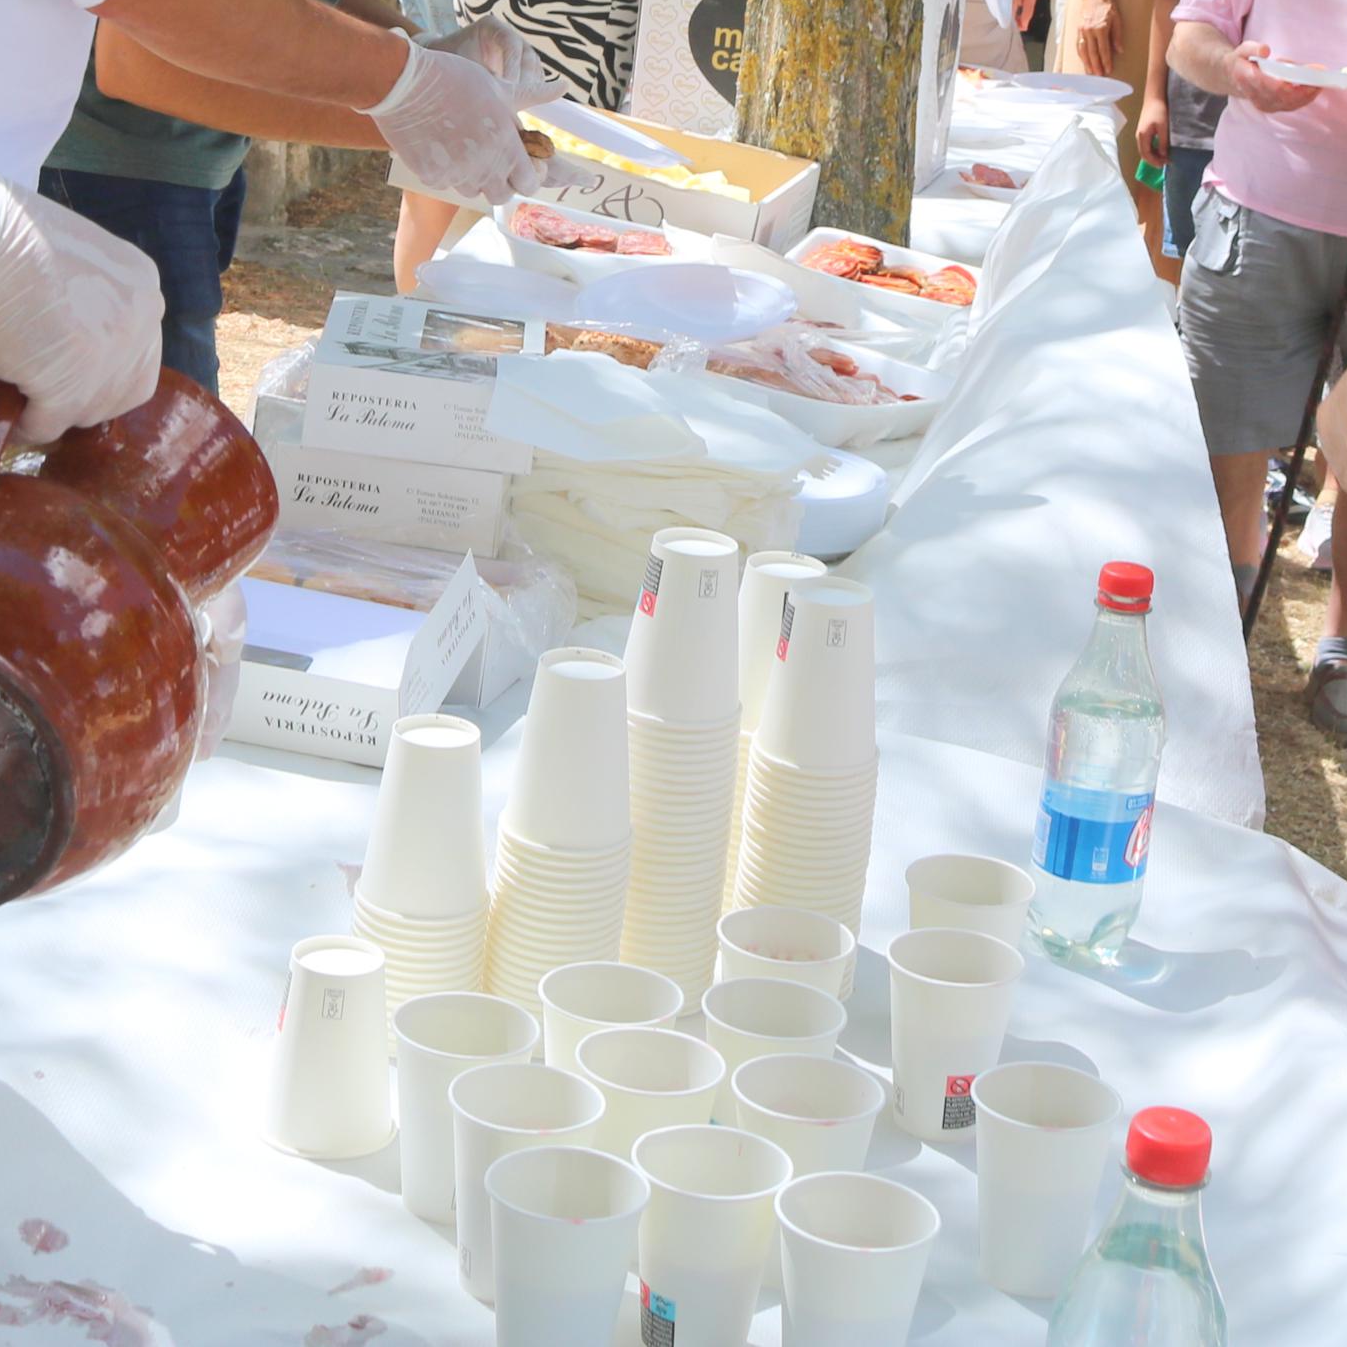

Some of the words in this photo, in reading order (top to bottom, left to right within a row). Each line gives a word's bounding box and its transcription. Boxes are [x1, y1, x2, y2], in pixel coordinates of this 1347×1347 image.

[331, 390, 417, 411] REPOSTERIA
[327, 404, 351, 423] La
[355, 405, 417, 432] Paloma
[297, 472, 381, 495] REPOSTERIA
[293, 485, 316, 505] La
[320, 489, 381, 516] Paloma
[262, 691, 341, 723] Paloma
[348, 706, 380, 733] La
[263, 715, 377, 746] REPOSTERIA
